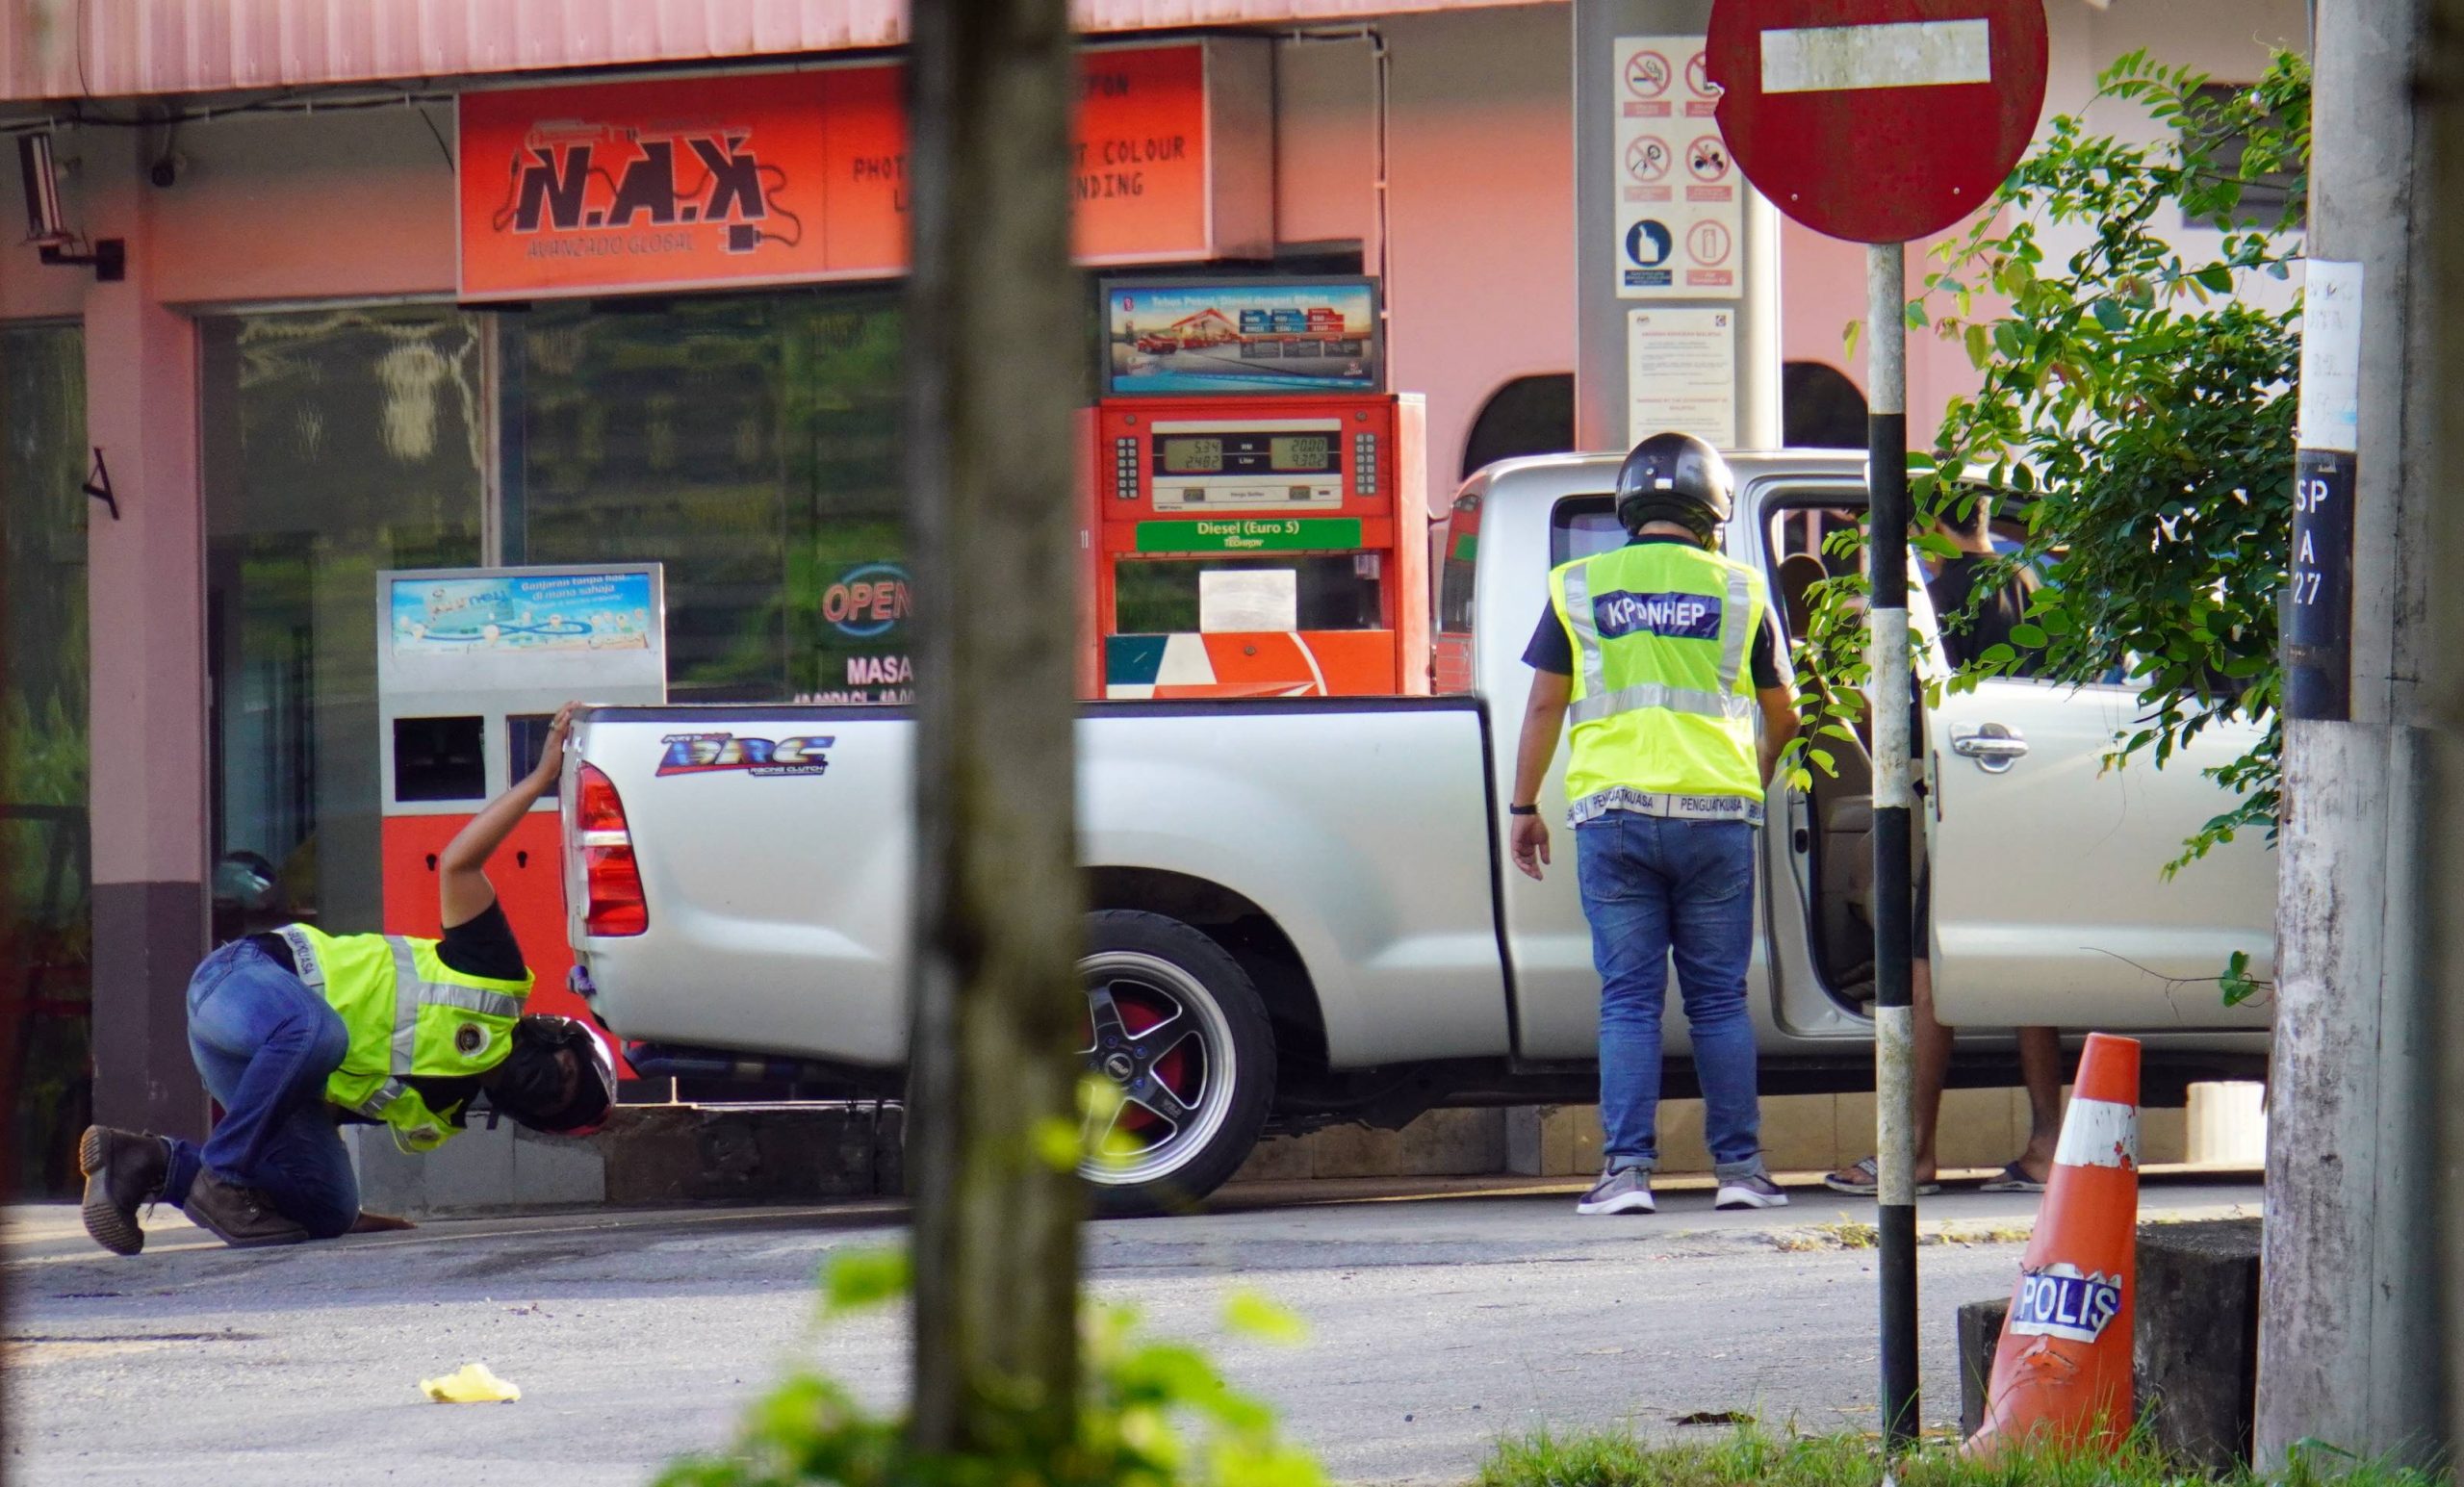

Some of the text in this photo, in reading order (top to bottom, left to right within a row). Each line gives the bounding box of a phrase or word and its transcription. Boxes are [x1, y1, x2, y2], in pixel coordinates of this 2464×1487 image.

[1104, 136, 1185, 165] COLOUR
[1077, 171, 1144, 199] NDING
[628, 232, 696, 255] GLOBAL
[2296, 478, 2328, 514] SP
[1197, 520, 1299, 536] Diesel (Euro 5)
[2299, 529, 2315, 564] A
[822, 579, 913, 623] OPEN
[2294, 572, 2322, 605] 27
[1607, 598, 1706, 627] KPDNHEP
[847, 655, 913, 685] MASA
[2019, 1276, 2117, 1329] POLIS
